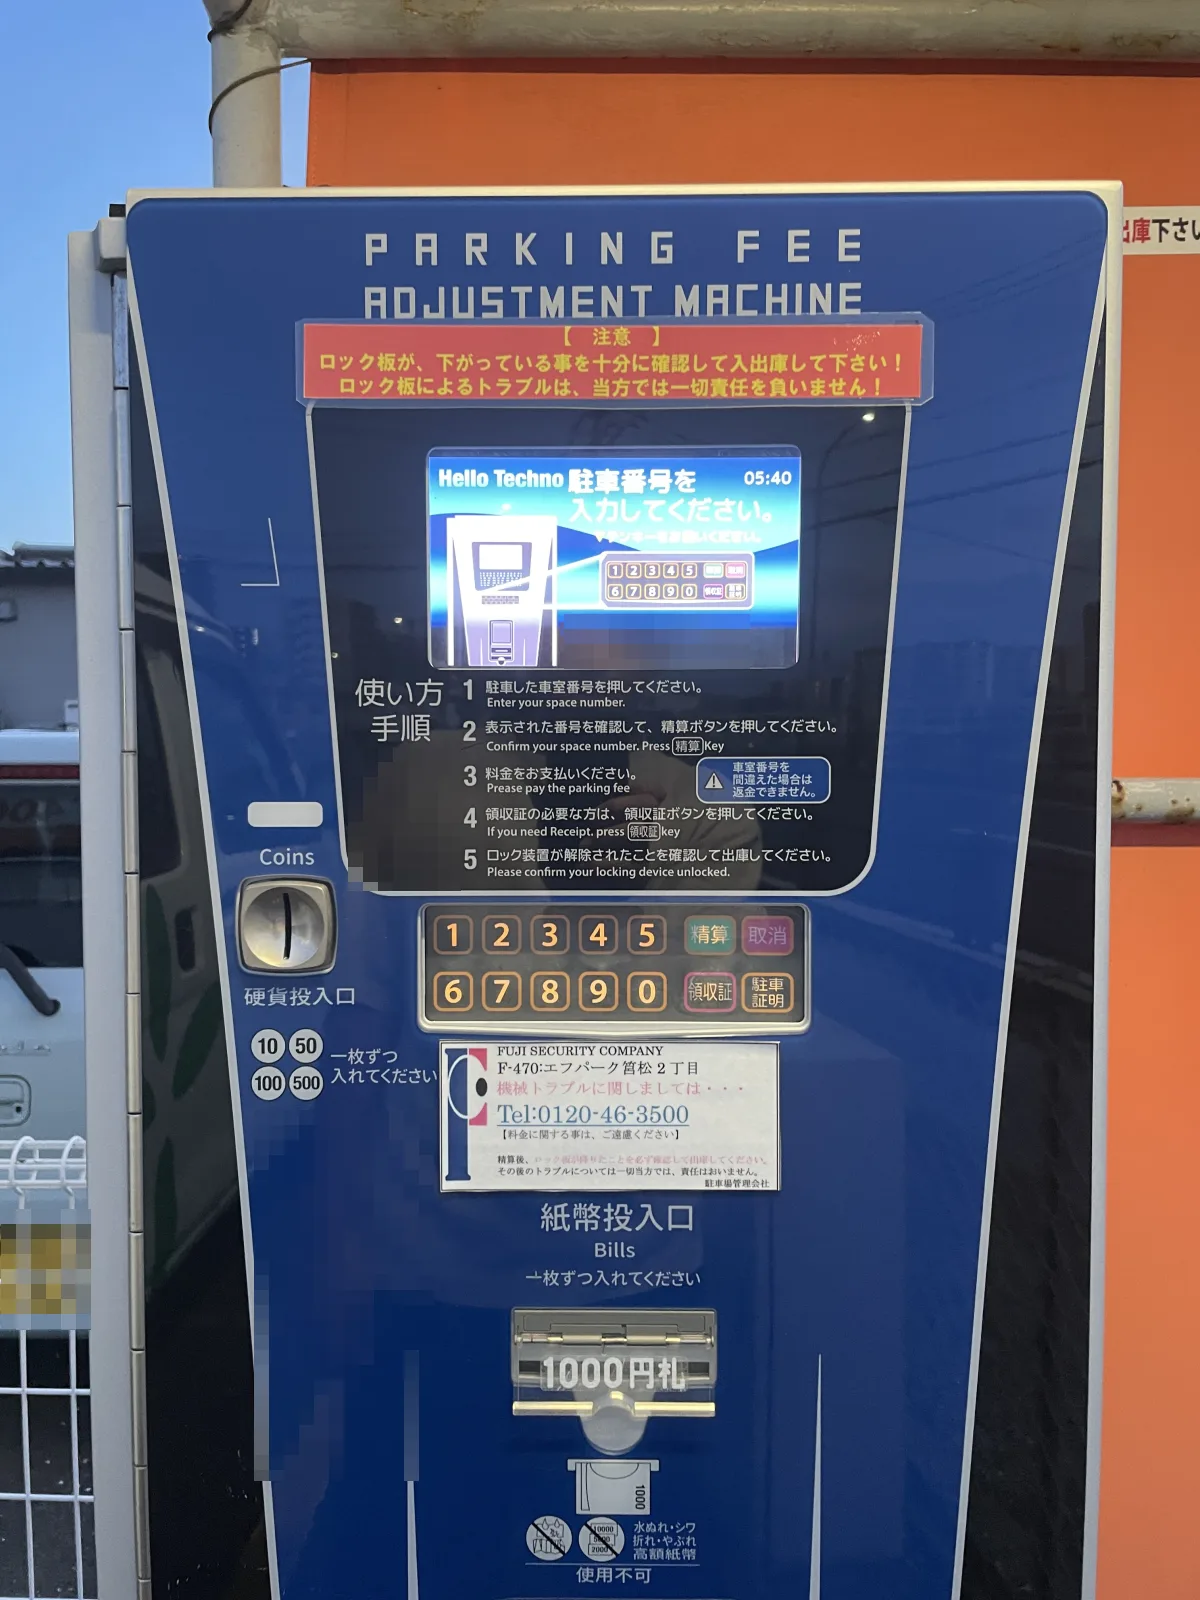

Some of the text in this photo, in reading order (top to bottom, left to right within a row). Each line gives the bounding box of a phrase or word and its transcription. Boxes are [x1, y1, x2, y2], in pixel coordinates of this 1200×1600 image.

[366, 229, 861, 266] PARKING FEE
[365, 282, 862, 319] ADJUSTMENT MACHINE
[438, 469, 564, 488] Hello Techno
[567, 468, 697, 495] 駐車番号を
[743, 471, 793, 486] 05:40
[568, 497, 773, 524] 入力してください。
[611, 565, 619, 576] 1
[630, 565, 638, 576] 2
[648, 565, 657, 576] 3
[666, 565, 676, 576] 4
[685, 565, 694, 576] 5
[611, 586, 694, 597] 6 7 8 9 0
[354, 678, 445, 708] 使い方
[463, 679, 474, 700] 1
[485, 680, 702, 695] 駐車した車室番号を押してください。
[487, 697, 626, 710] Enter your space number.
[371, 714, 431, 742] 手順
[463, 720, 477, 742] 2
[486, 739, 725, 753] Confirm your space number. Press 精算 Key
[485, 766, 637, 781] 料金をお支払いください。
[732, 761, 790, 773] 車室番号を
[463, 765, 477, 787] 3
[732, 774, 813, 785] 間違えた場合は
[487, 782, 631, 795] Prease pay the parking fee
[732, 786, 816, 798] 返金できません。
[463, 807, 478, 828] 4
[487, 825, 681, 839] If you need Receipt. press 領収証 key
[259, 847, 315, 866] Coins
[463, 849, 478, 870] 5
[487, 866, 731, 879] Please confirm your locking device unlocked.
[445, 922, 787, 948] 1 2 3 4 5 精算 取消
[443, 978, 733, 1004] 6 7 8 9 0 領収証
[751, 976, 785, 992] 駐車
[243, 986, 356, 1007] 硬貨投入口
[751, 993, 785, 1008] 証明
[257, 1038, 317, 1055] 10 50
[497, 1045, 664, 1057] FUJI SECURITY COMPANY
[330, 1047, 399, 1065] 一枚ずつ
[254, 1075, 321, 1092] 100 500
[330, 1067, 438, 1086] 入れてください
[497, 1104, 689, 1124] Tel:0120-46-3500
[540, 1202, 694, 1232] 紙幣投入口
[594, 1241, 636, 1258] Bills
[525, 1270, 701, 1287] 一枚ずつ入れてください
[543, 1356, 686, 1390] 1000円札
[635, 1484, 646, 1510] 1000
[632, 1534, 697, 1547] 折れ・やぶれ
[633, 1548, 697, 1561] 高額紙幣
[575, 1567, 652, 1584] 使用不可
